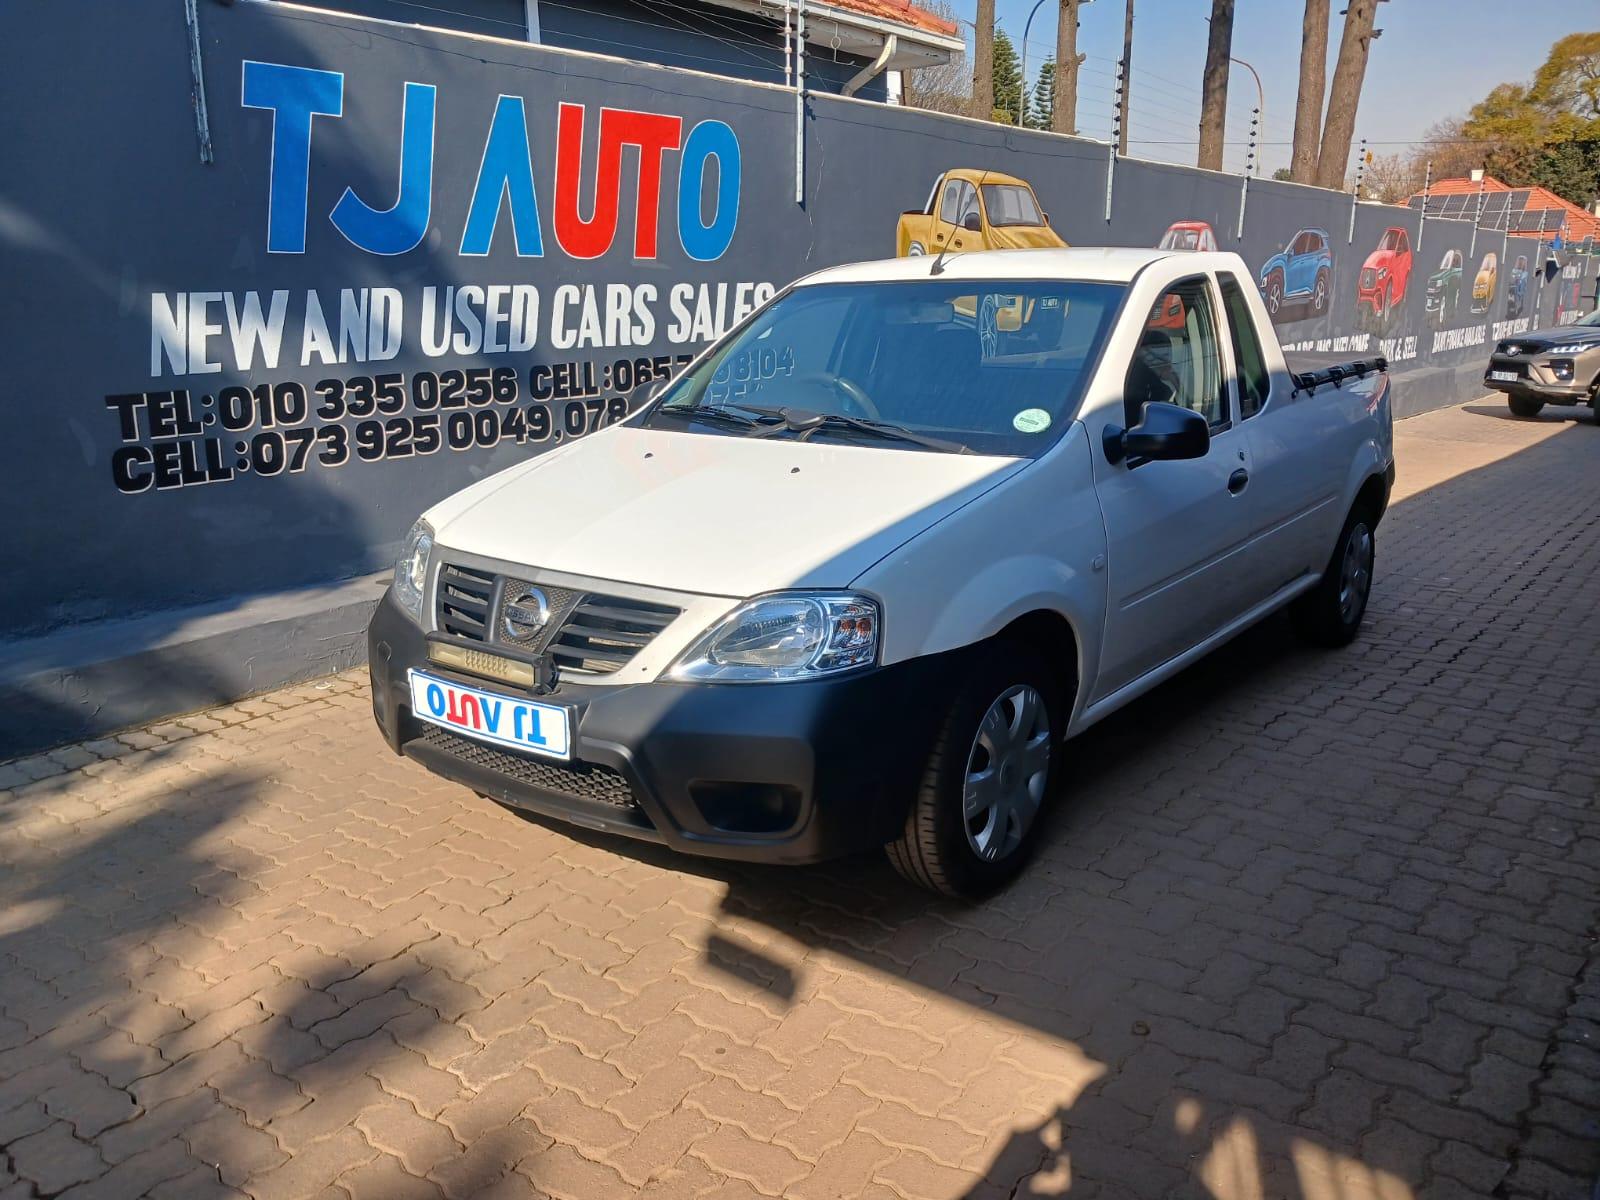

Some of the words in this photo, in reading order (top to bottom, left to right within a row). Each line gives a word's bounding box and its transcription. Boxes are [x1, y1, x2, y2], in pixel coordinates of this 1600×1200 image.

[240, 59, 437, 256] TJ
[458, 93, 742, 262] AUTO
[150, 289, 290, 377] NEW
[299, 287, 404, 366] AND
[420, 284, 538, 358] USED
[550, 282, 657, 349] CARS
[316, 372, 408, 422] 335
[412, 366, 520, 411] 0256
[355, 415, 441, 463] 925
